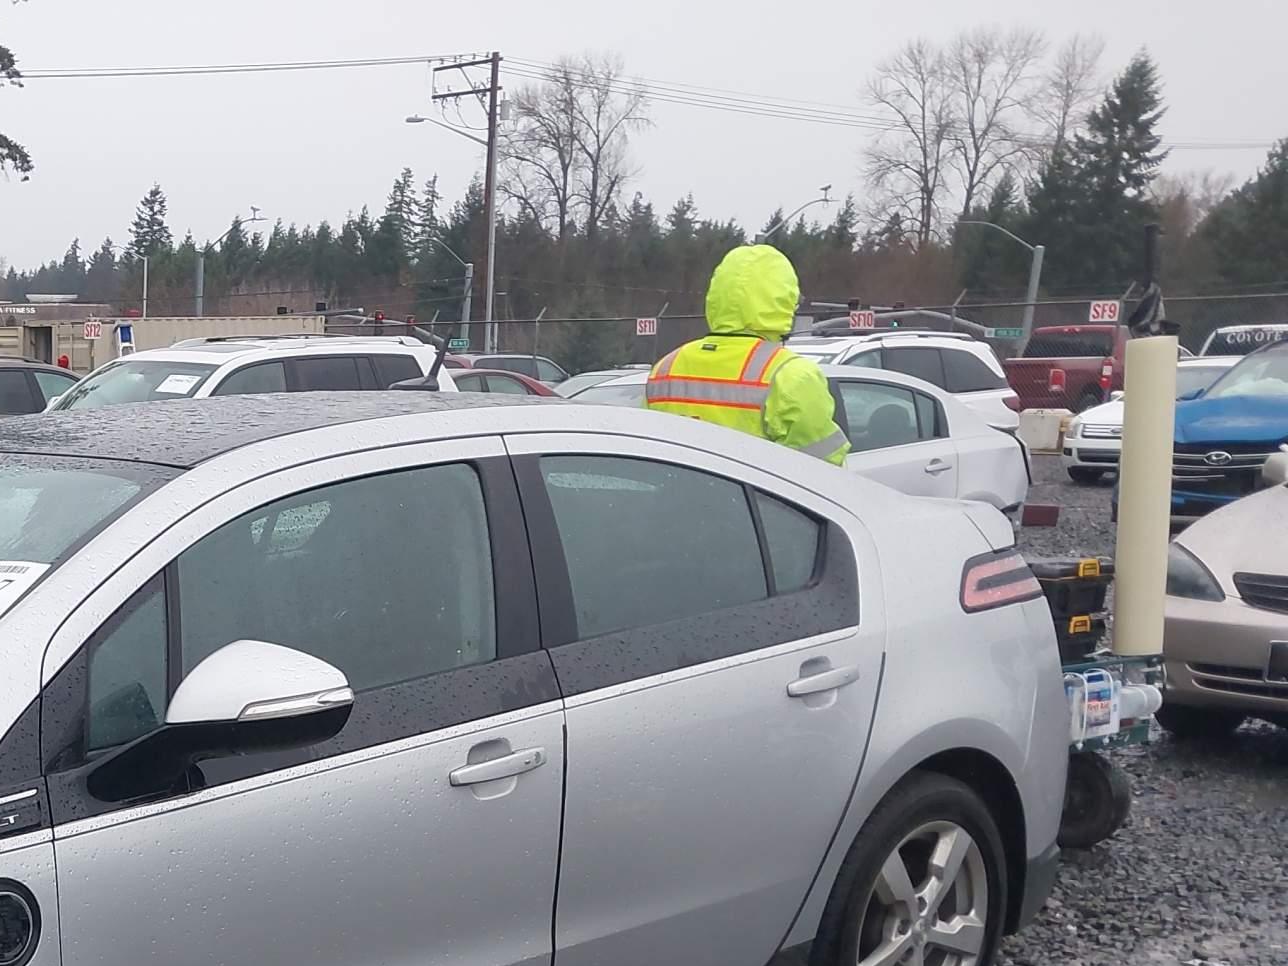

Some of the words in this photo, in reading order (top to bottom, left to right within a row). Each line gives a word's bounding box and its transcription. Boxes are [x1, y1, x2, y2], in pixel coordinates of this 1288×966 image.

[5, 306, 36, 314] FITNESS
[1092, 302, 1117, 319] SF9
[638, 319, 655, 334] SF11
[850, 312, 873, 328] SF10
[85, 323, 101, 337] SF12
[1226, 329, 1284, 344] COYOTE
